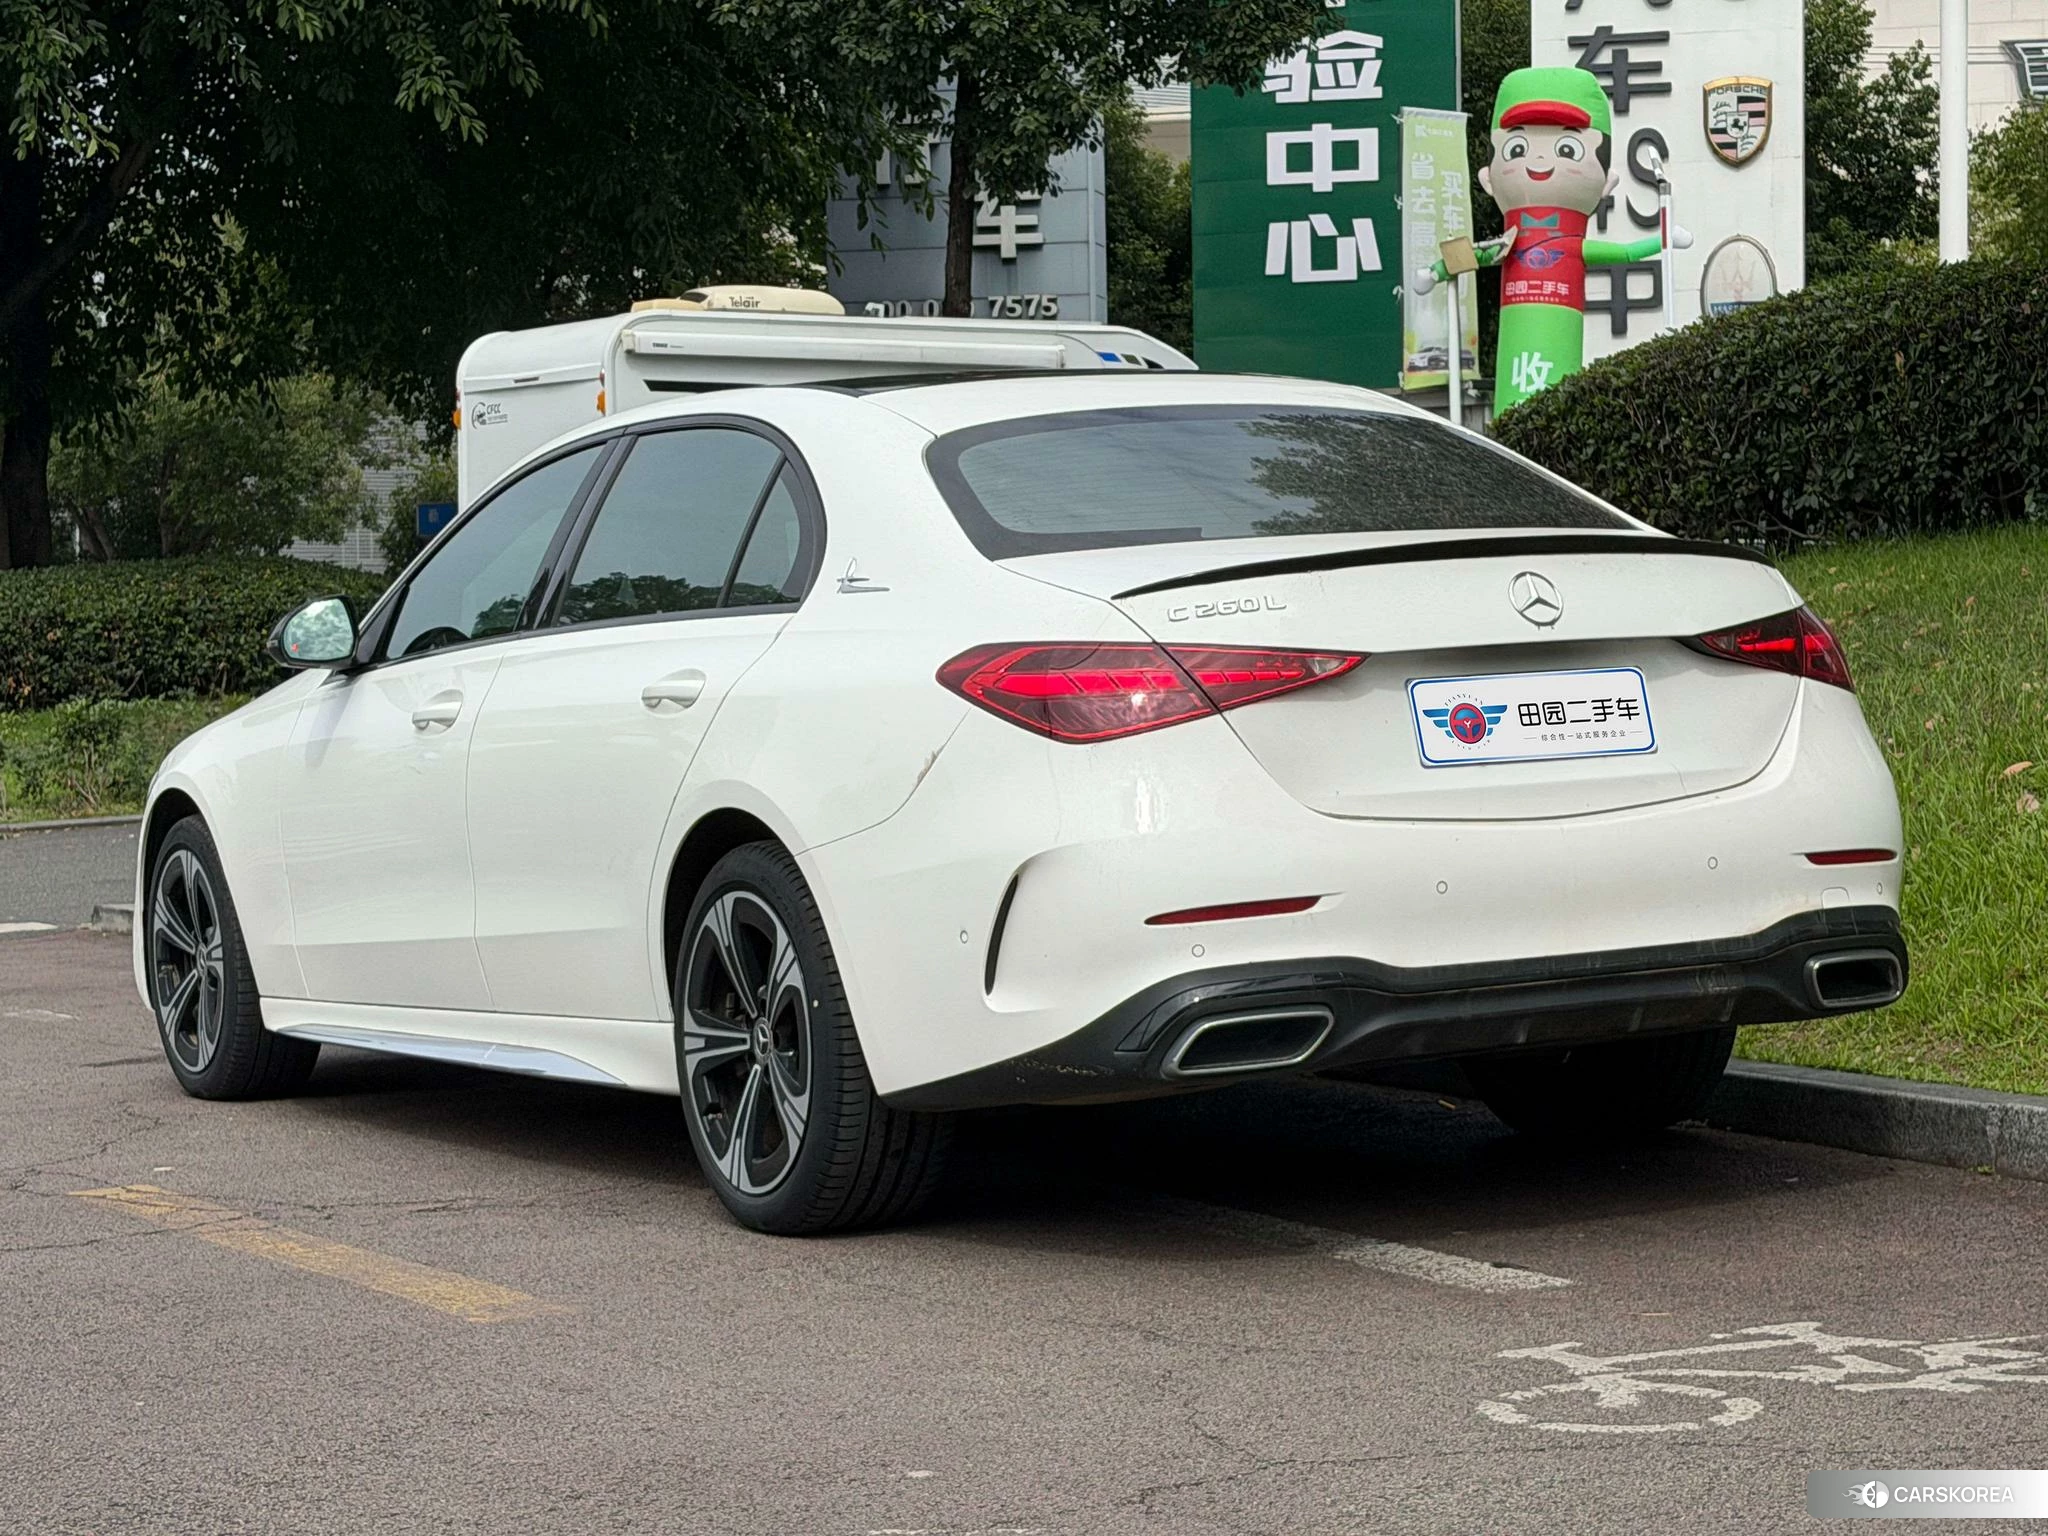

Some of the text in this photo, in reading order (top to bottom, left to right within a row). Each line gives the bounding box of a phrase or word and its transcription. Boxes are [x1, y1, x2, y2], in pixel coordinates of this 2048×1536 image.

[1261, 0, 1384, 283] 验中心
[988, 294, 1058, 318] 7575
[1511, 351, 1553, 393] 收
[1167, 594, 1288, 622] C 260 L
[1518, 697, 1641, 727] 田园二手车
